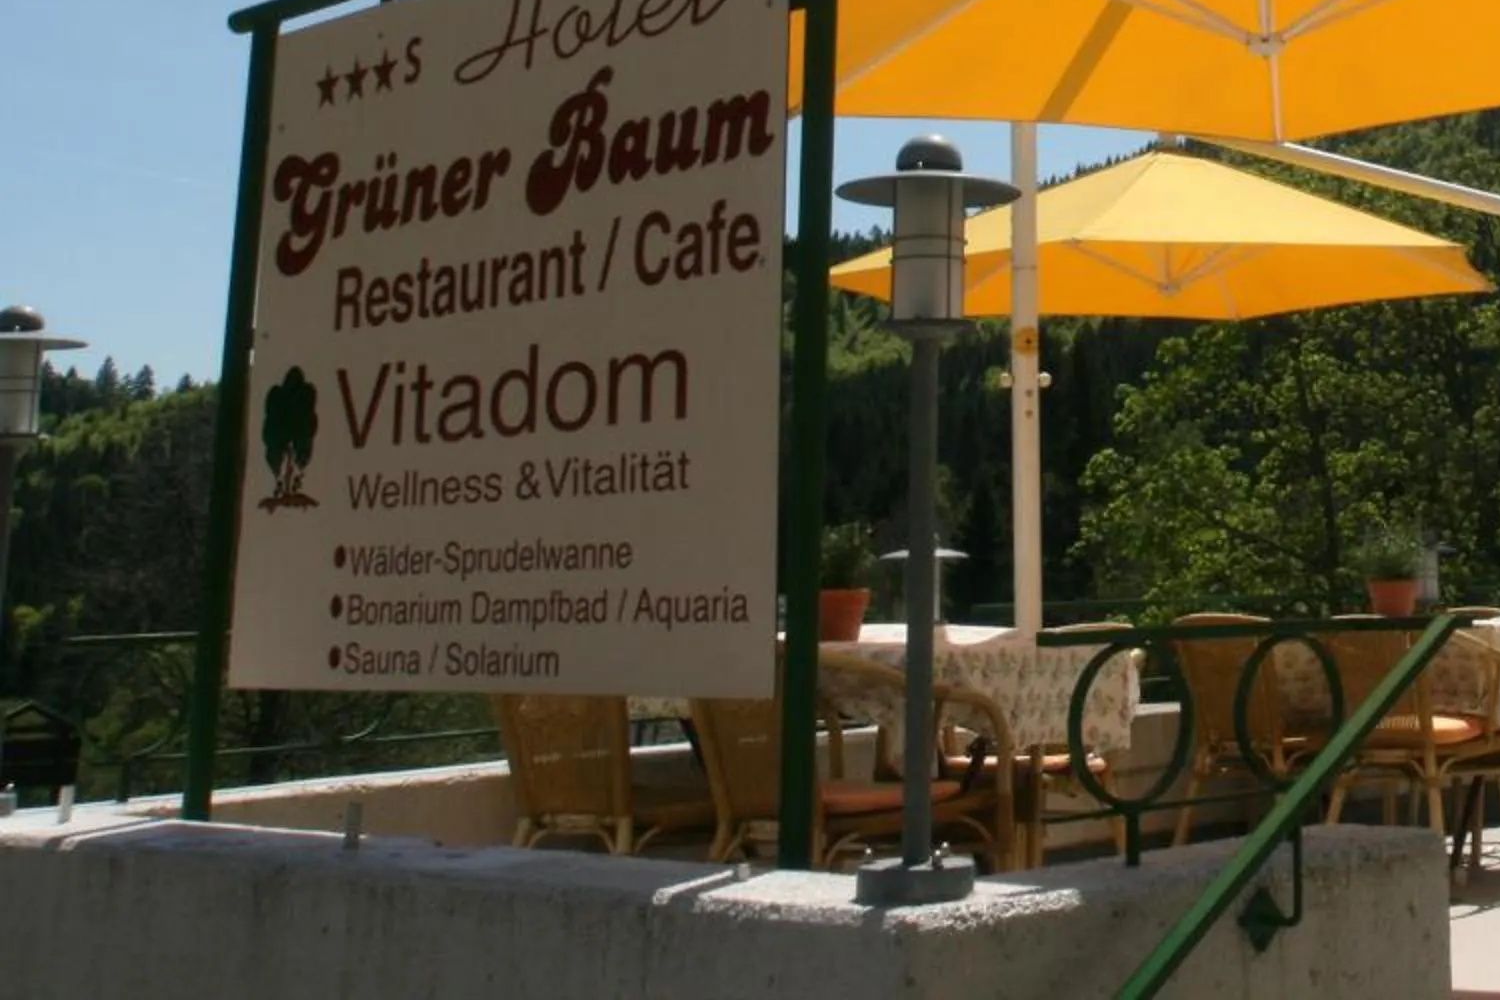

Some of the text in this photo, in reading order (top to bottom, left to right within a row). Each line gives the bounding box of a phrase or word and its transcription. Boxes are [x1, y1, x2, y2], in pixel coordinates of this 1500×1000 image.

[273, 65, 775, 277] Grüner Baum
[333, 229, 587, 332] Restaurant
[634, 199, 761, 287] Cafe
[337, 344, 689, 450] Vitadom
[348, 450, 691, 509] Wellness & Vitalität
[349, 538, 632, 588] Wälder-Sprudelwanne
[346, 591, 462, 628] Bonarium
[471, 588, 608, 632] Dampfbad
[633, 586, 750, 632] Aquaria
[344, 643, 420, 676] Sauna
[445, 642, 560, 678] Solarium
